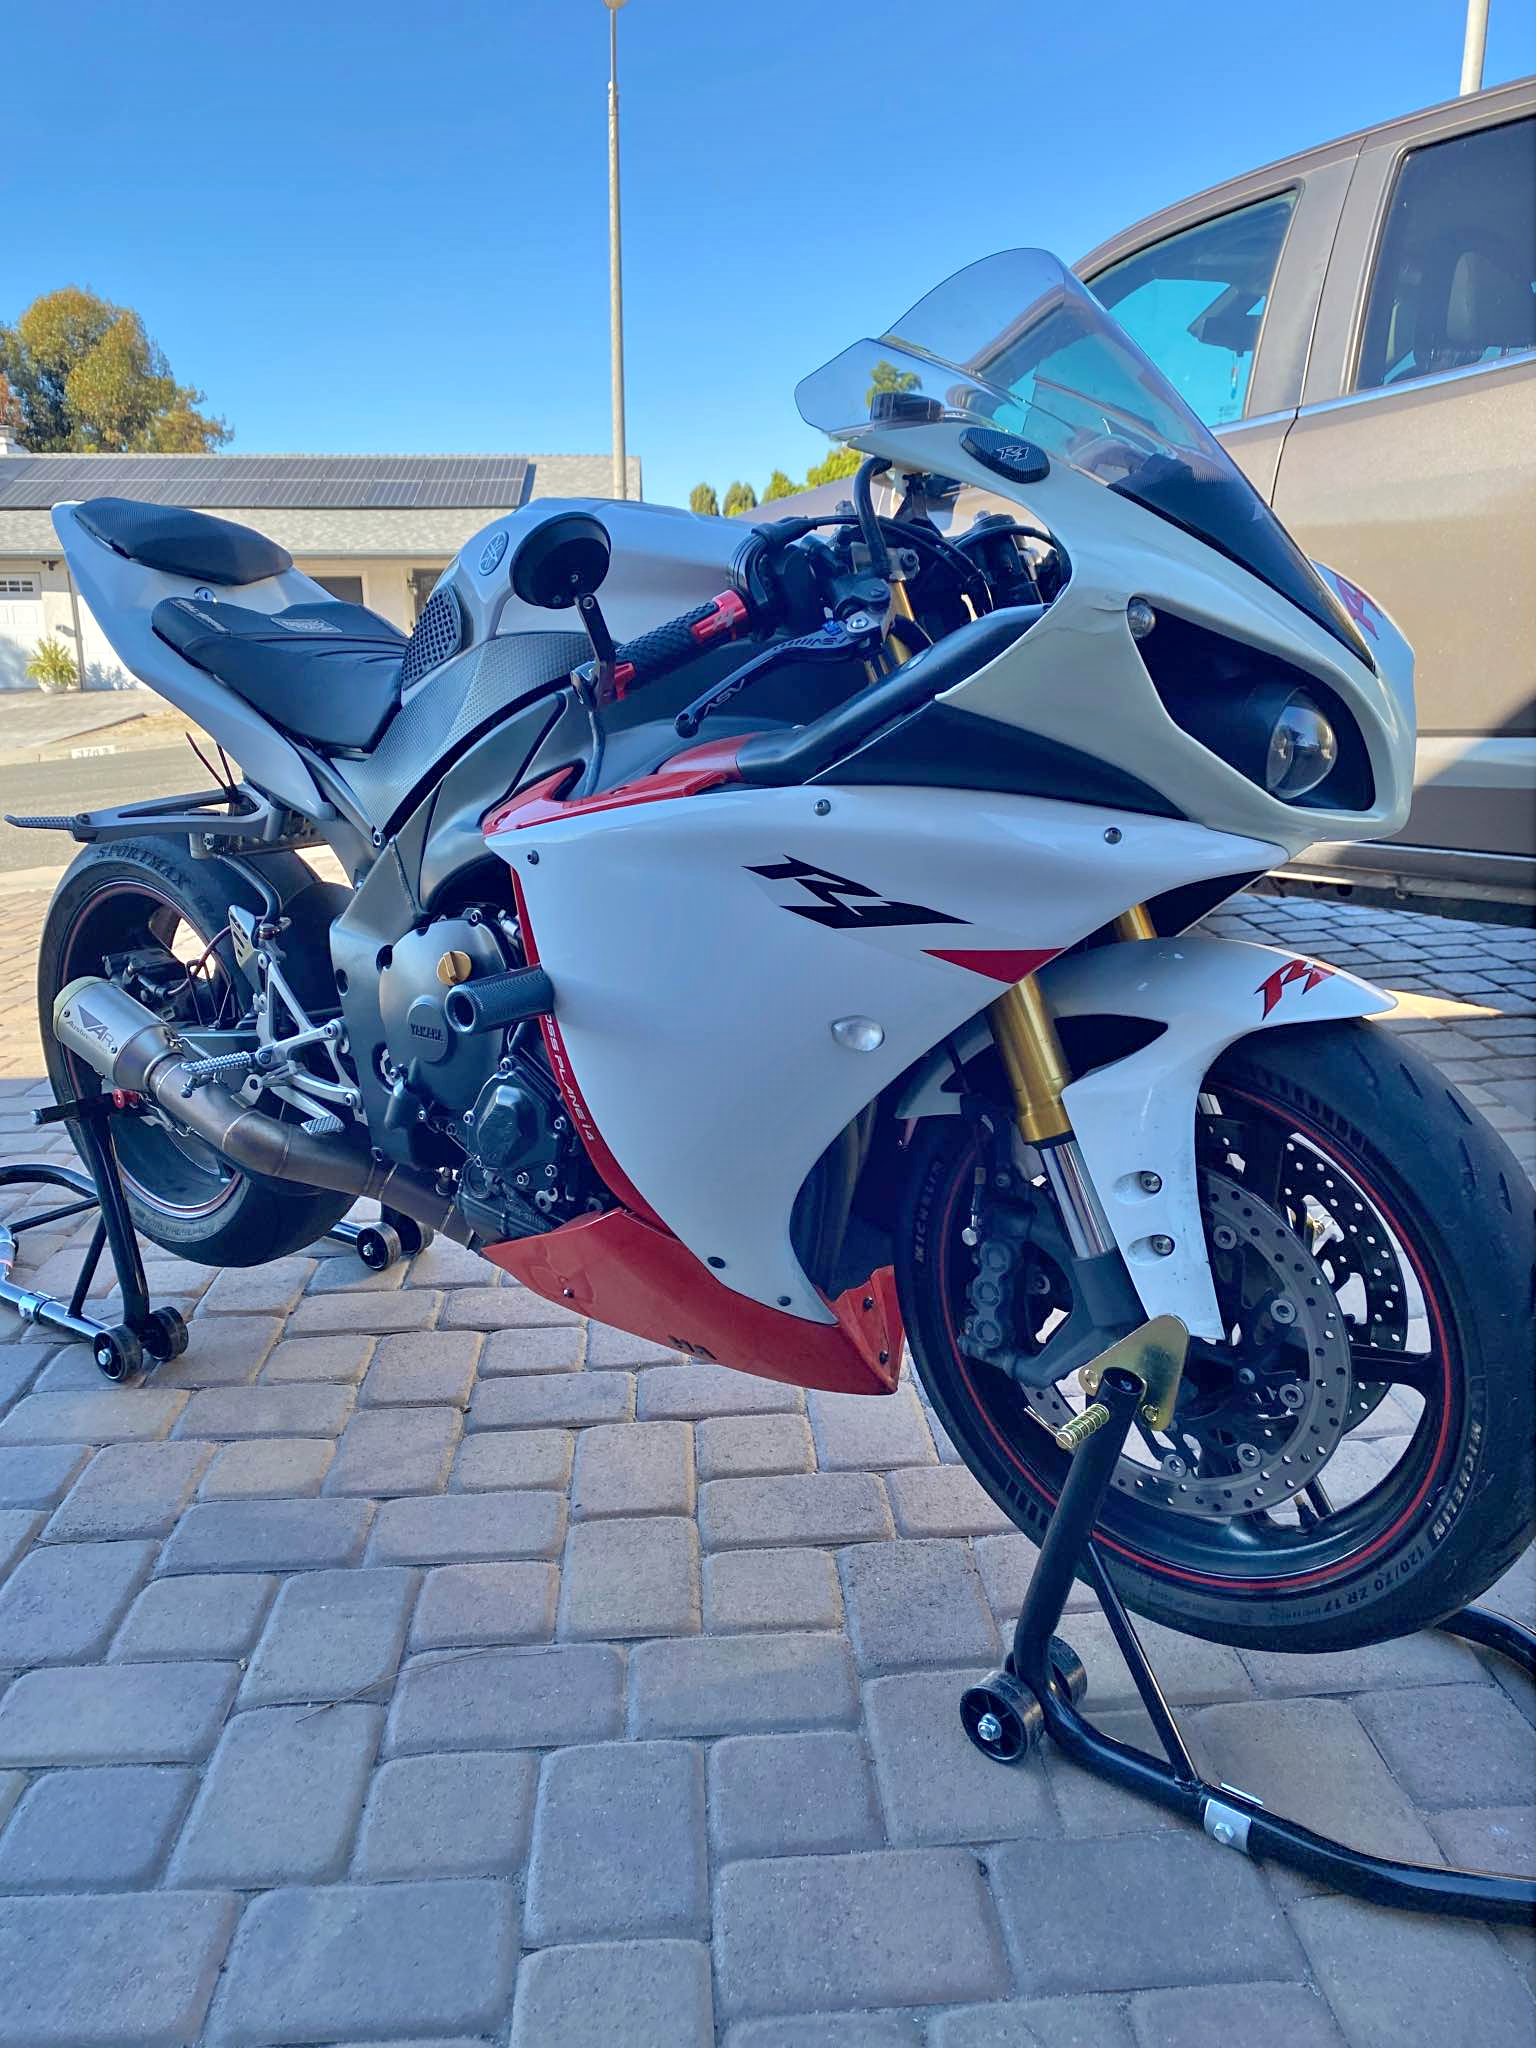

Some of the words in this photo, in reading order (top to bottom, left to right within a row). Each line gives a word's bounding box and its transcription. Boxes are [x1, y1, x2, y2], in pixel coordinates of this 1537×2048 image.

[704, 679, 745, 716] ASV
[97, 845, 192, 889] SPORTMAX
[410, 1024, 443, 1041] YAMAHA
[545, 1015, 560, 1051] OSS
[555, 1055, 586, 1120] PLANE
[1432, 1423, 1482, 1540] MICHELIN
[1374, 1547, 1425, 1592] 120/70
[1324, 1599, 1341, 1613] 17
[1349, 1588, 1369, 1604] ZR
